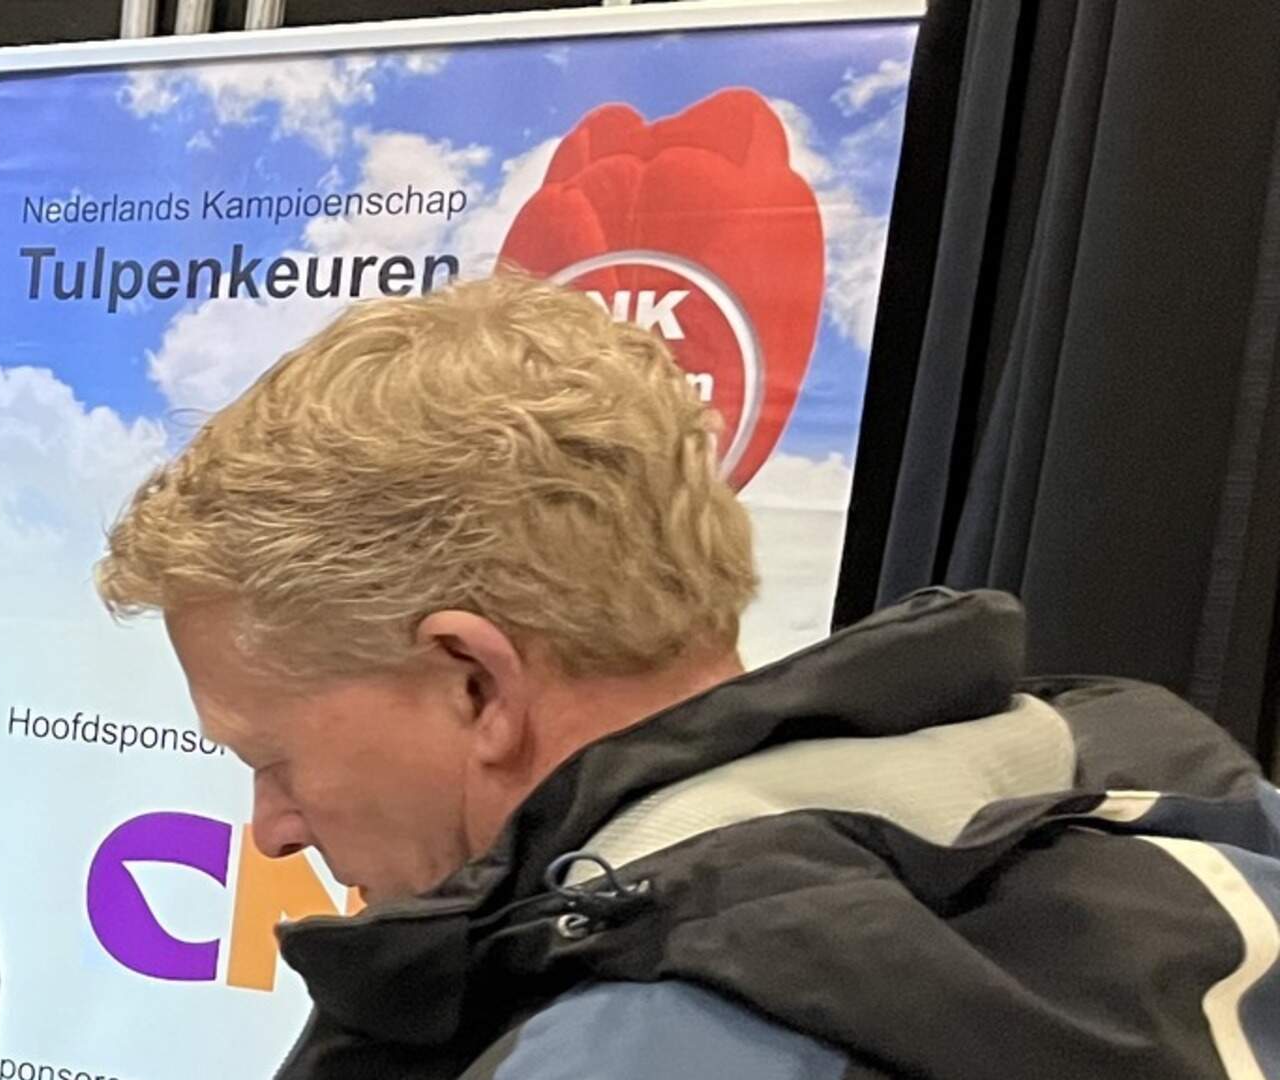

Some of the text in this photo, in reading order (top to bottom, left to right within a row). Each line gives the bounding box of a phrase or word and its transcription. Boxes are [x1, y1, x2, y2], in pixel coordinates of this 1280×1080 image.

[23, 186, 468, 225] Nederlands Kampioenschap
[19, 244, 461, 314] Tulpenkeuren
[8, 706, 225, 756] Hoofdsponso
